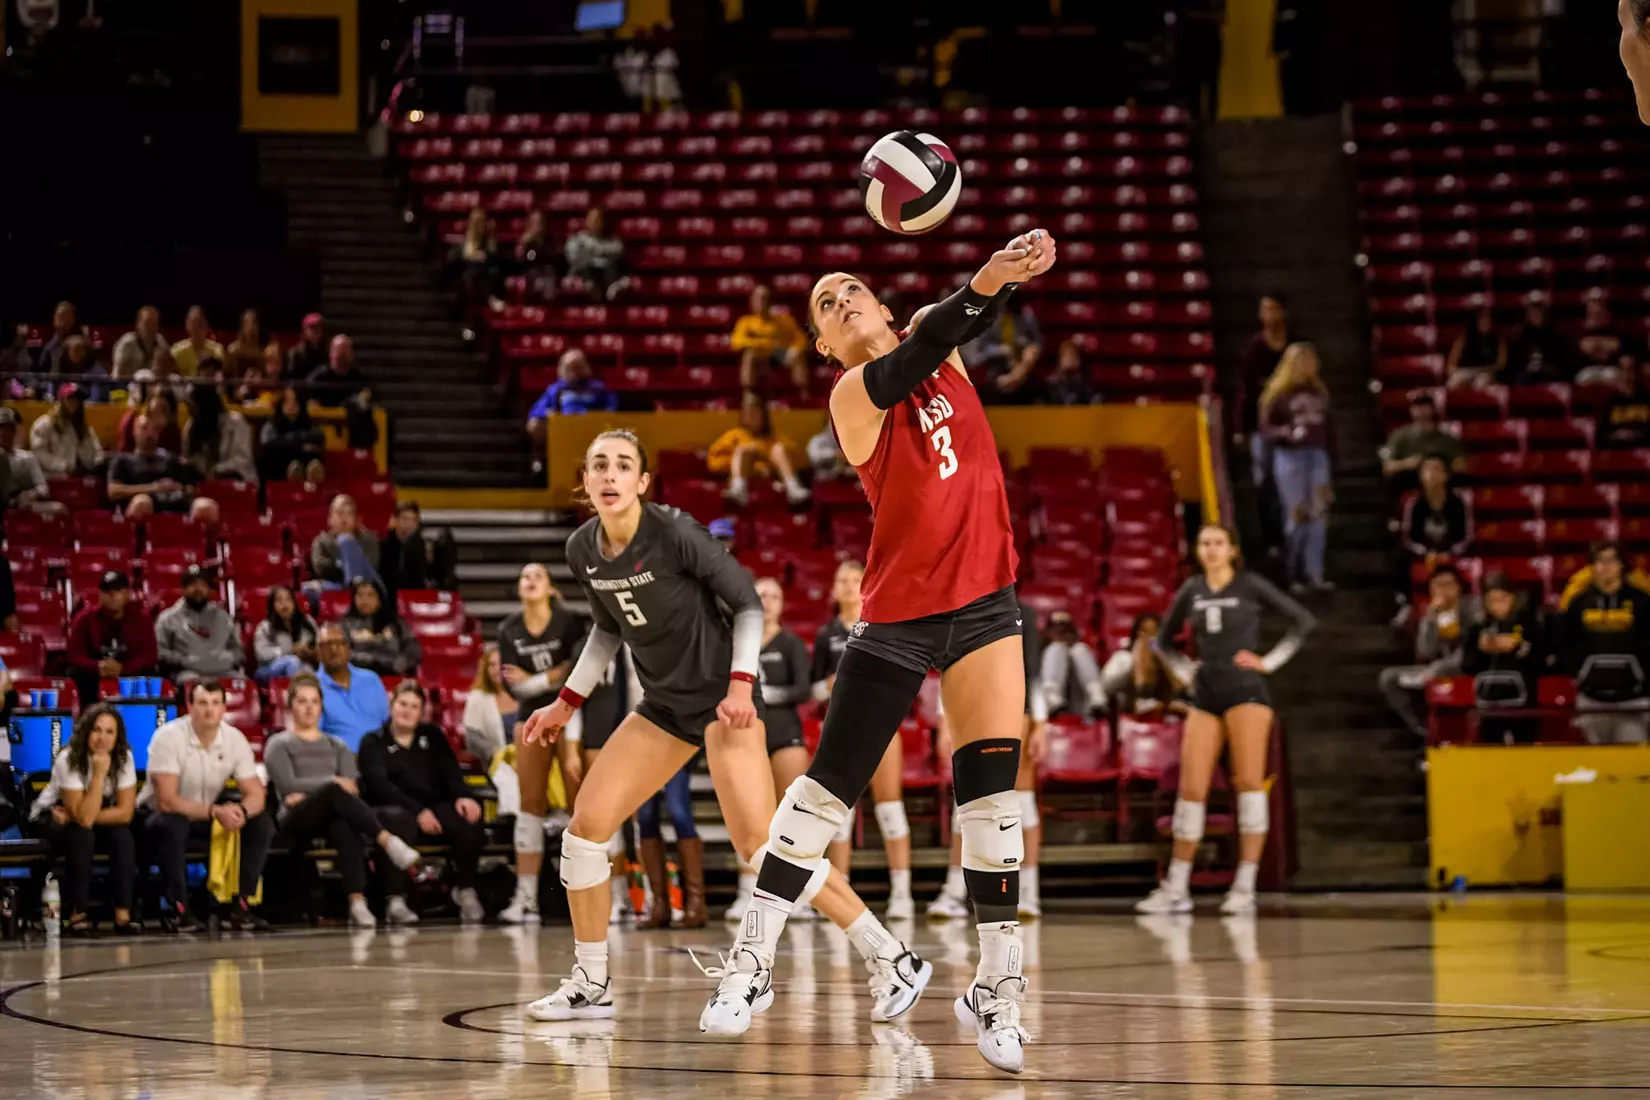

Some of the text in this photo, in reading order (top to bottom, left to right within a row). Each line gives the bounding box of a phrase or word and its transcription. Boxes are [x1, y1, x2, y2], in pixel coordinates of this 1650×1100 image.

[930, 425, 958, 480] 3
[628, 570, 655, 587] STATE
[614, 591, 648, 627] 5
